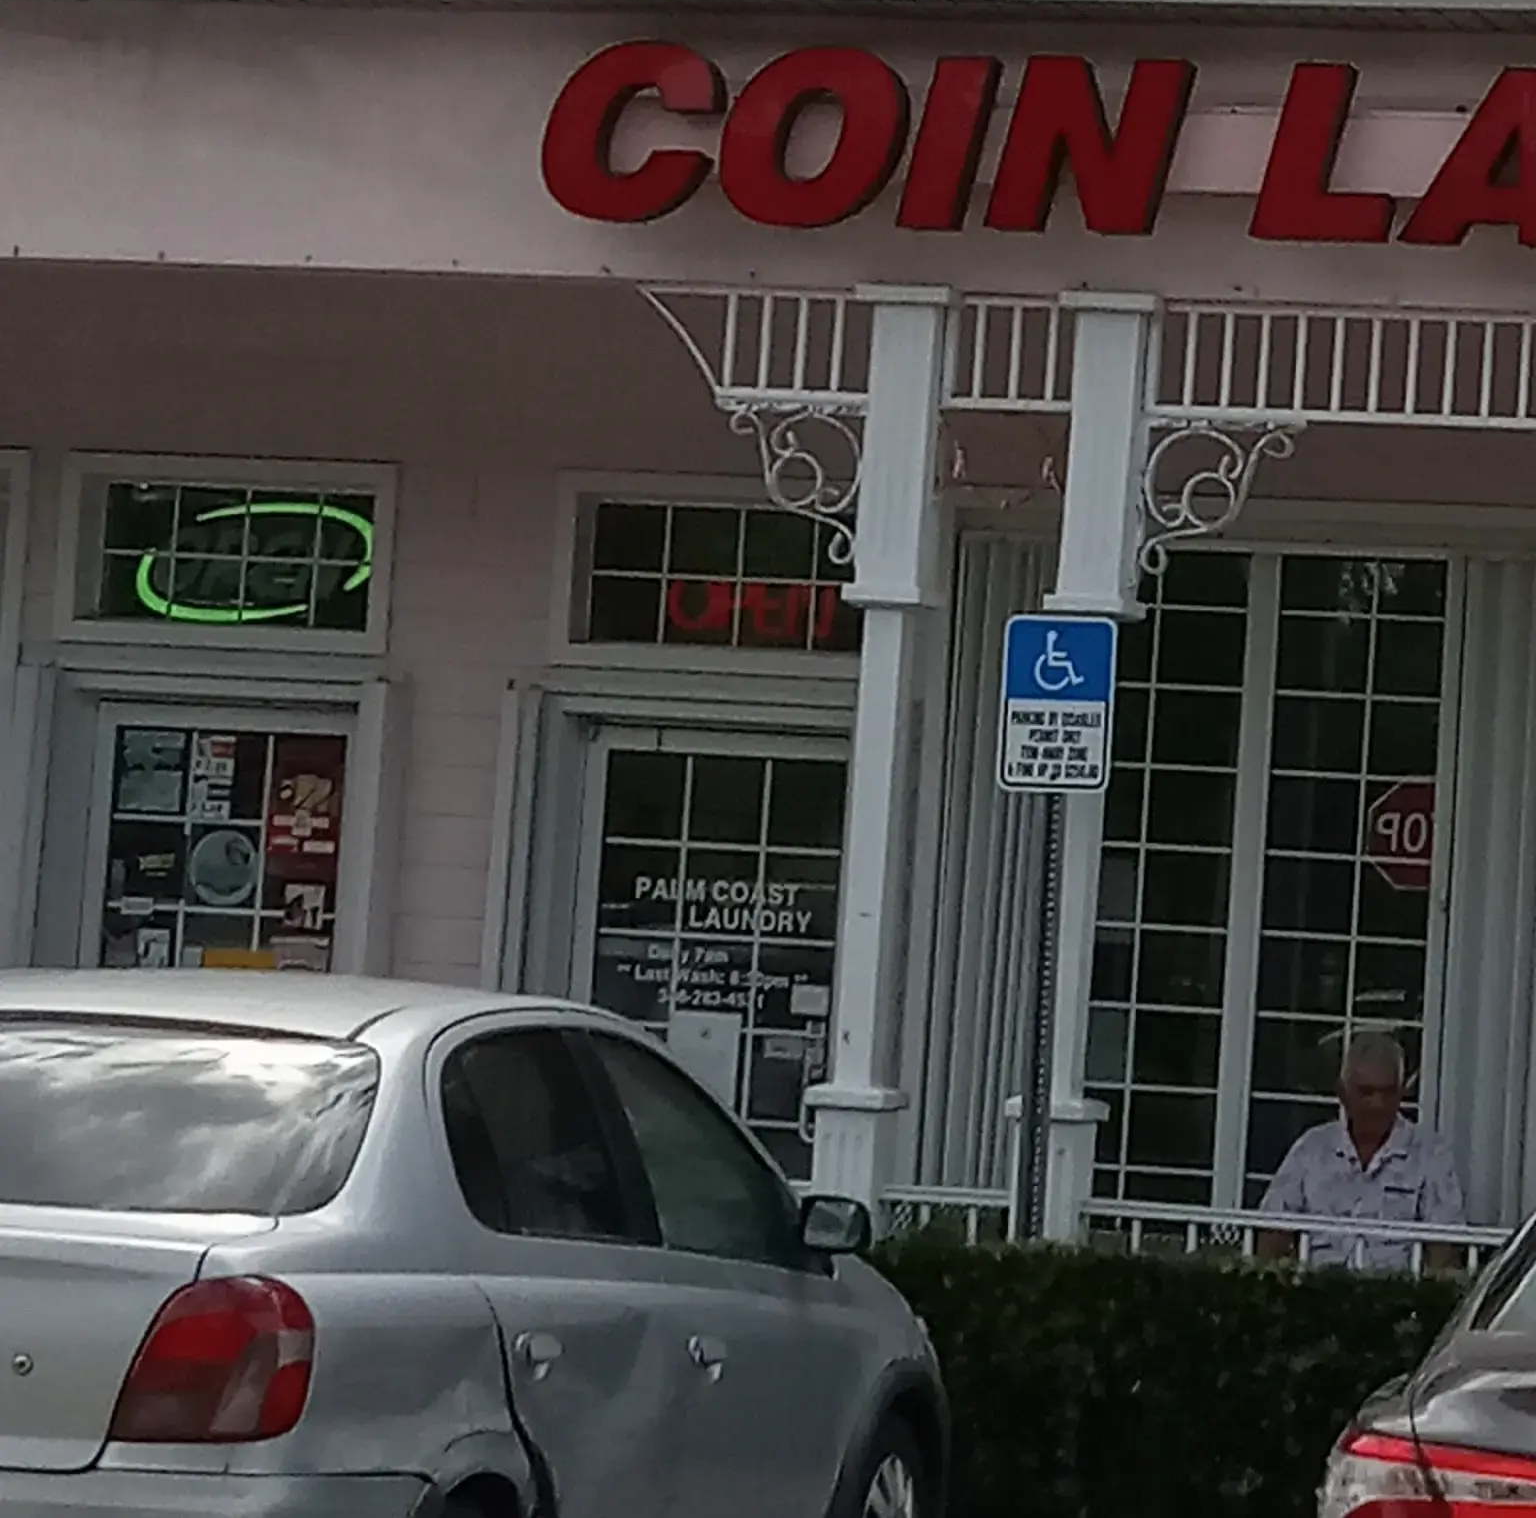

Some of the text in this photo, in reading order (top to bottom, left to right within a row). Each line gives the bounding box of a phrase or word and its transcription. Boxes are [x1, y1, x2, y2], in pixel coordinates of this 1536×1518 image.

[541, 38, 1197, 236] COIN
[635, 876, 800, 907] PALM COAST
[689, 905, 812, 933] LAUNDRY
